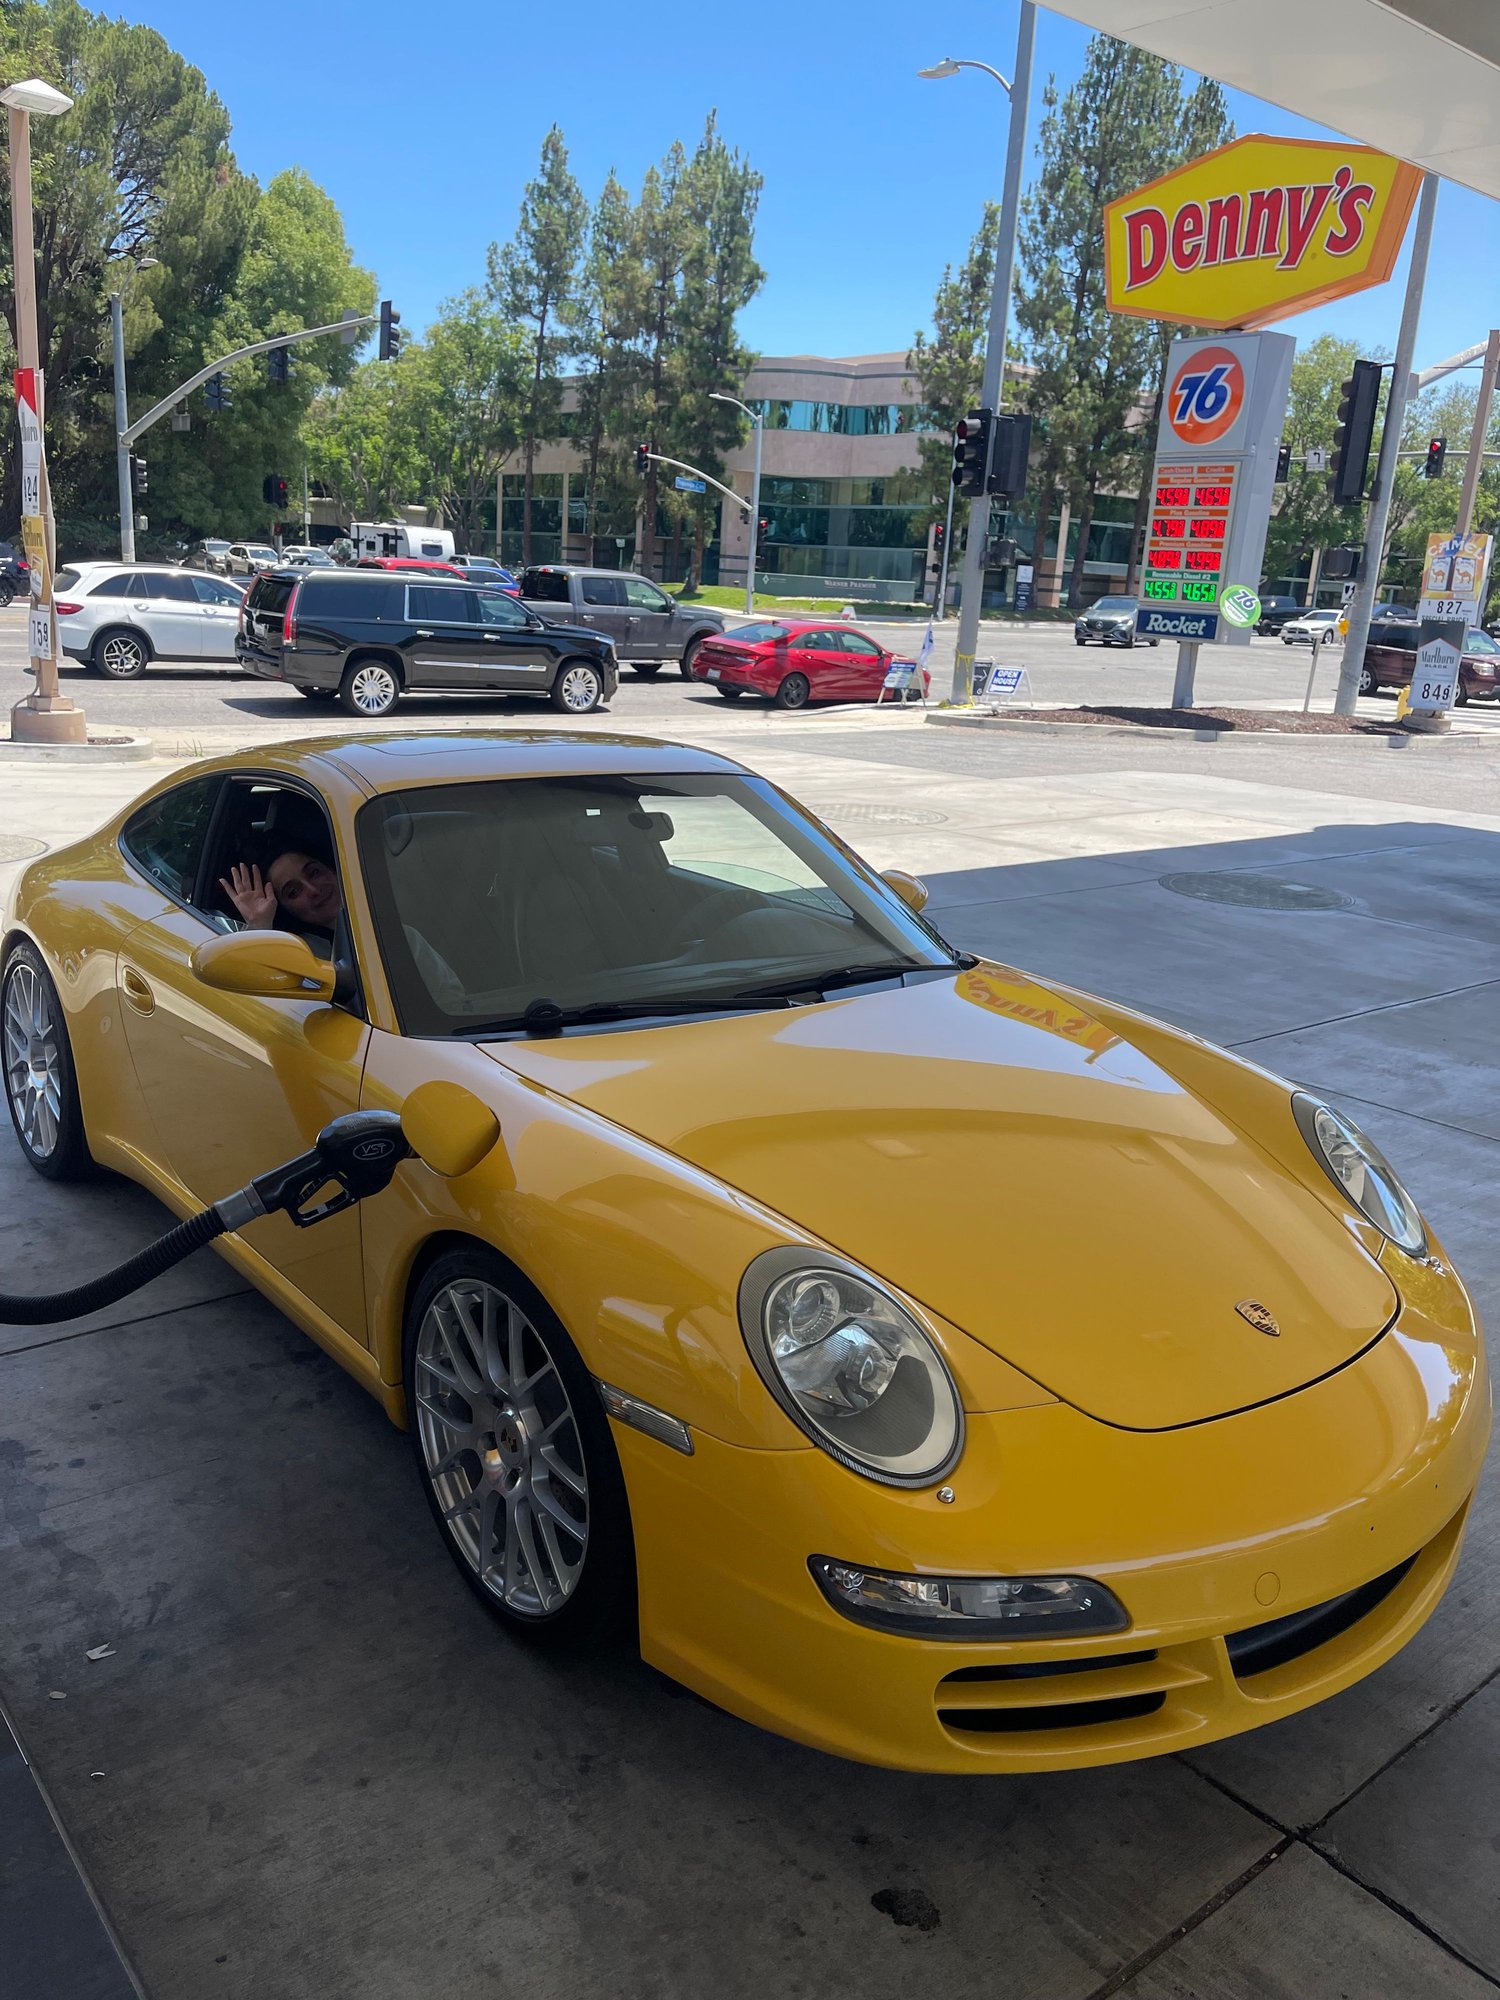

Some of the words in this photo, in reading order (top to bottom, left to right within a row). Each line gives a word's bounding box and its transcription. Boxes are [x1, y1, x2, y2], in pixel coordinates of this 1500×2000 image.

[1123, 165, 1376, 291] Denny's
[1173, 363, 1236, 424] 76
[1427, 540, 1484, 560] CAMEL
[1233, 589, 1260, 610] 76
[1436, 601, 1463, 615] 827
[1146, 614, 1206, 635] Rocket
[1422, 647, 1455, 664] Marlboro
[992, 677, 1017, 685] HOUSE
[997, 670, 1019, 678] OPEN
[1421, 683, 1451, 701] 849
[362, 1143, 387, 1155] VST
